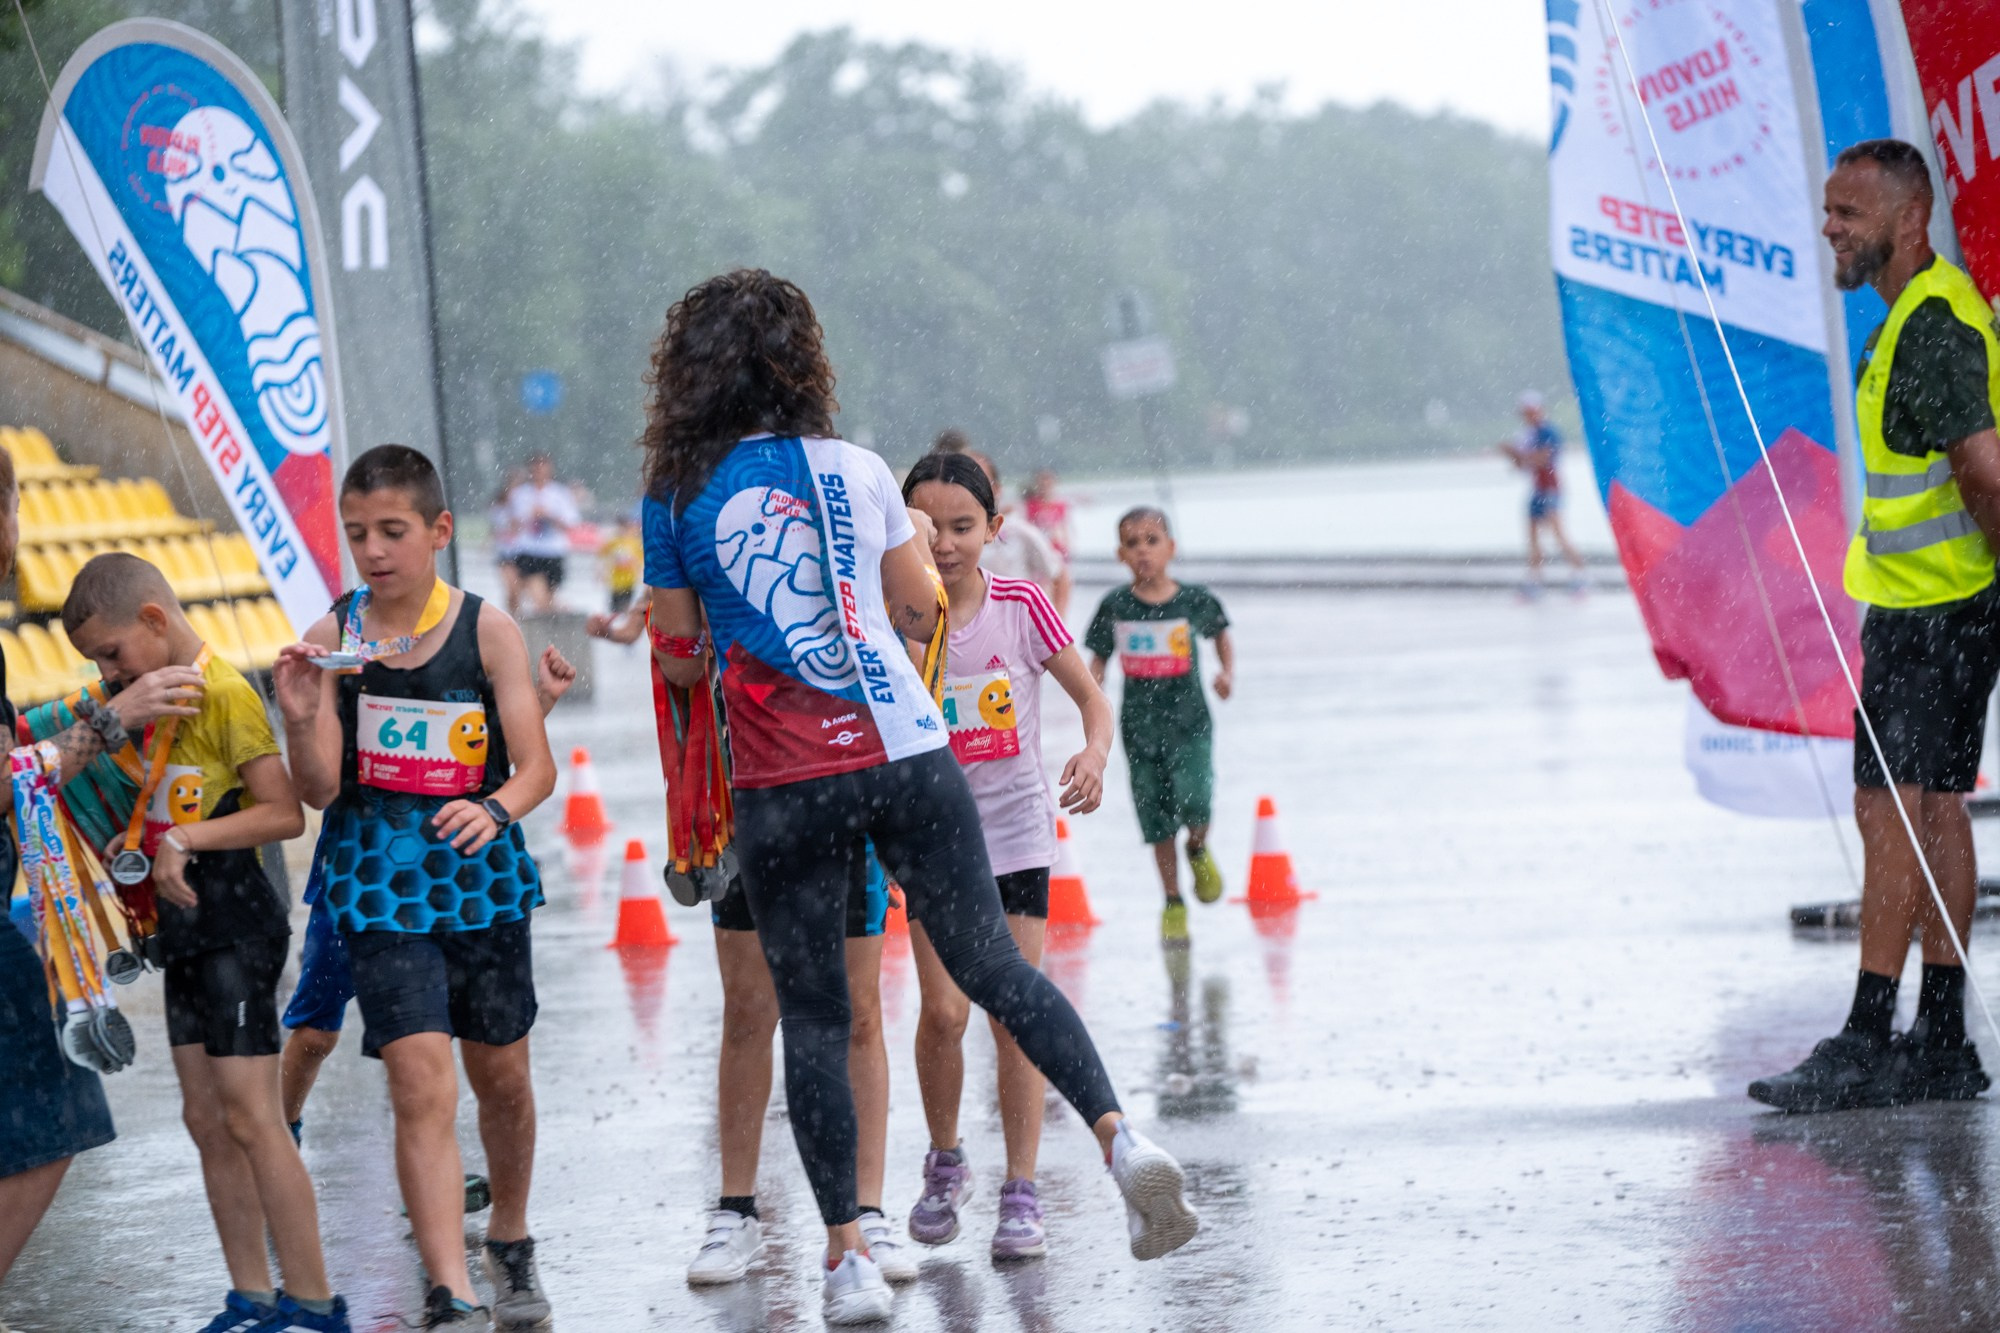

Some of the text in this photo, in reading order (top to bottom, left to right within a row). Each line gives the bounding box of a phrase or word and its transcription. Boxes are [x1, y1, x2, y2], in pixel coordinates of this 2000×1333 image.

[770, 493, 811, 509] PLOVDIV
[774, 505, 800, 518] HILLS
[818, 473, 856, 580] MATTERS
[839, 581, 867, 643] STEP
[832, 712, 858, 725] AIGER
[377, 716, 428, 751] 64
